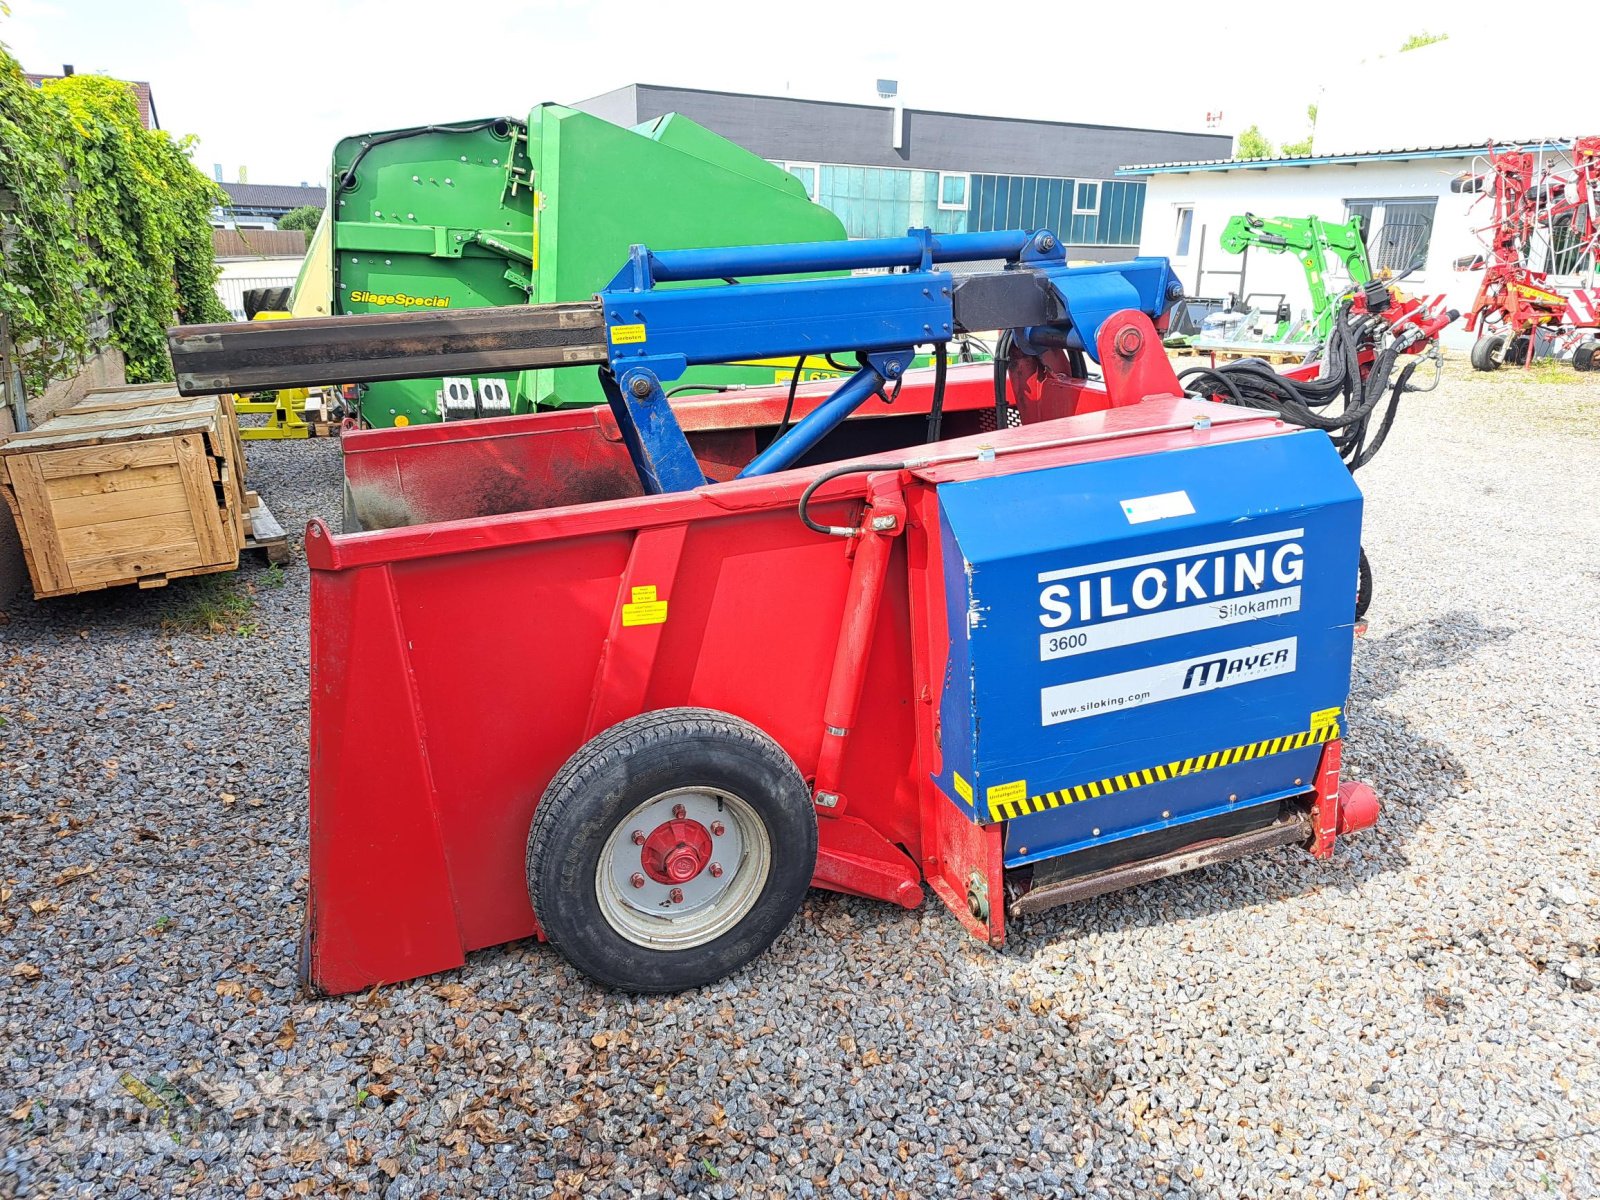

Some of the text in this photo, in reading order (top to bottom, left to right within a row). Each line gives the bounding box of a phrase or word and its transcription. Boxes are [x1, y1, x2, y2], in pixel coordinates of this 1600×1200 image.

[350, 290, 450, 308] SilageSpecial
[1038, 543, 1304, 628] SILOKING
[1049, 595, 1292, 652] 3600 Silokamm
[1182, 648, 1289, 690] MAYER
[1051, 690, 1151, 718] www.siloking.com
